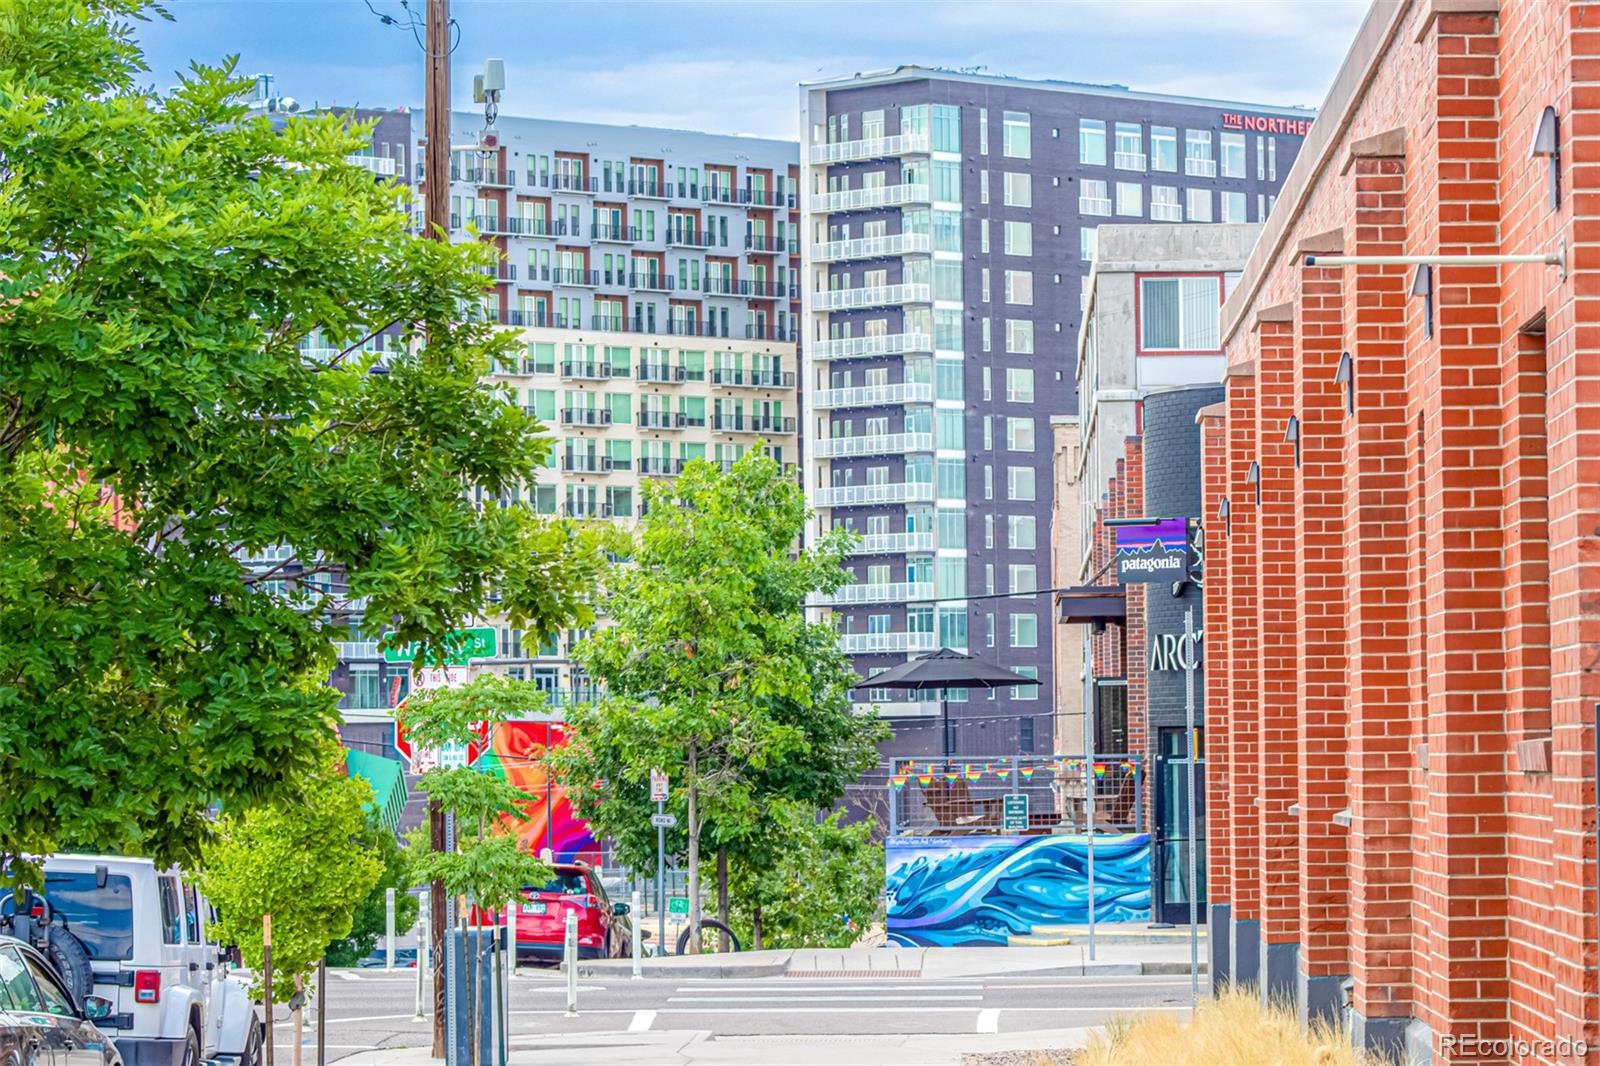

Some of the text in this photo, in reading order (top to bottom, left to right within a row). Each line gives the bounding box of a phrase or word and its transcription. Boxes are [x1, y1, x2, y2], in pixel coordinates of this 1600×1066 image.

[1223, 113, 1242, 125] THE
[1121, 556, 1182, 573] patagonia
[474, 638, 486, 649] St
